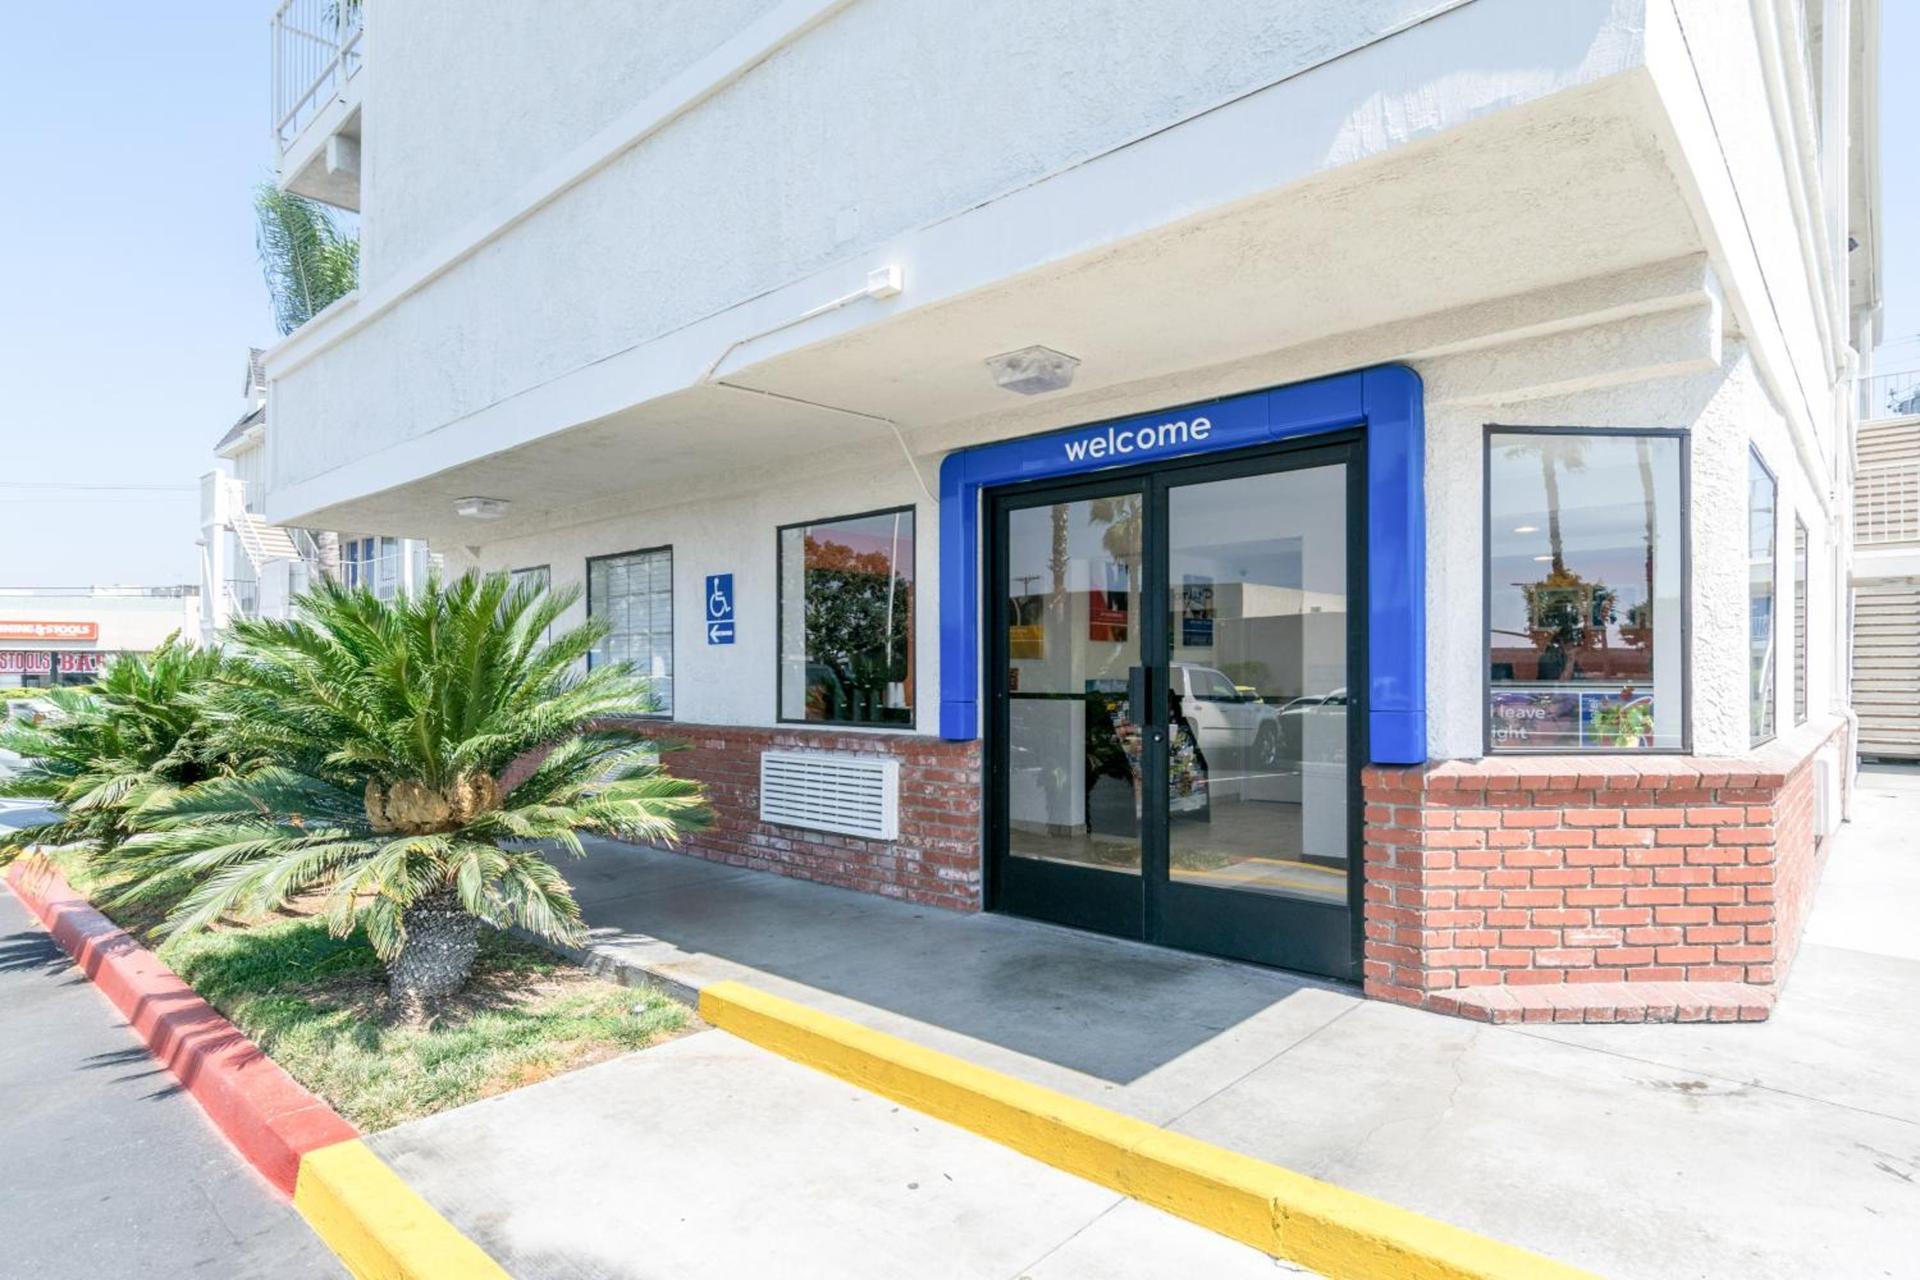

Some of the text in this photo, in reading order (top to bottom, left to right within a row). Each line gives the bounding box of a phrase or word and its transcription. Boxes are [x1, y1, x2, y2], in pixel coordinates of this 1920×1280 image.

[1065, 417, 1212, 462] welcome
[1500, 703, 1546, 719] leave
[1491, 724, 1528, 742] ight
